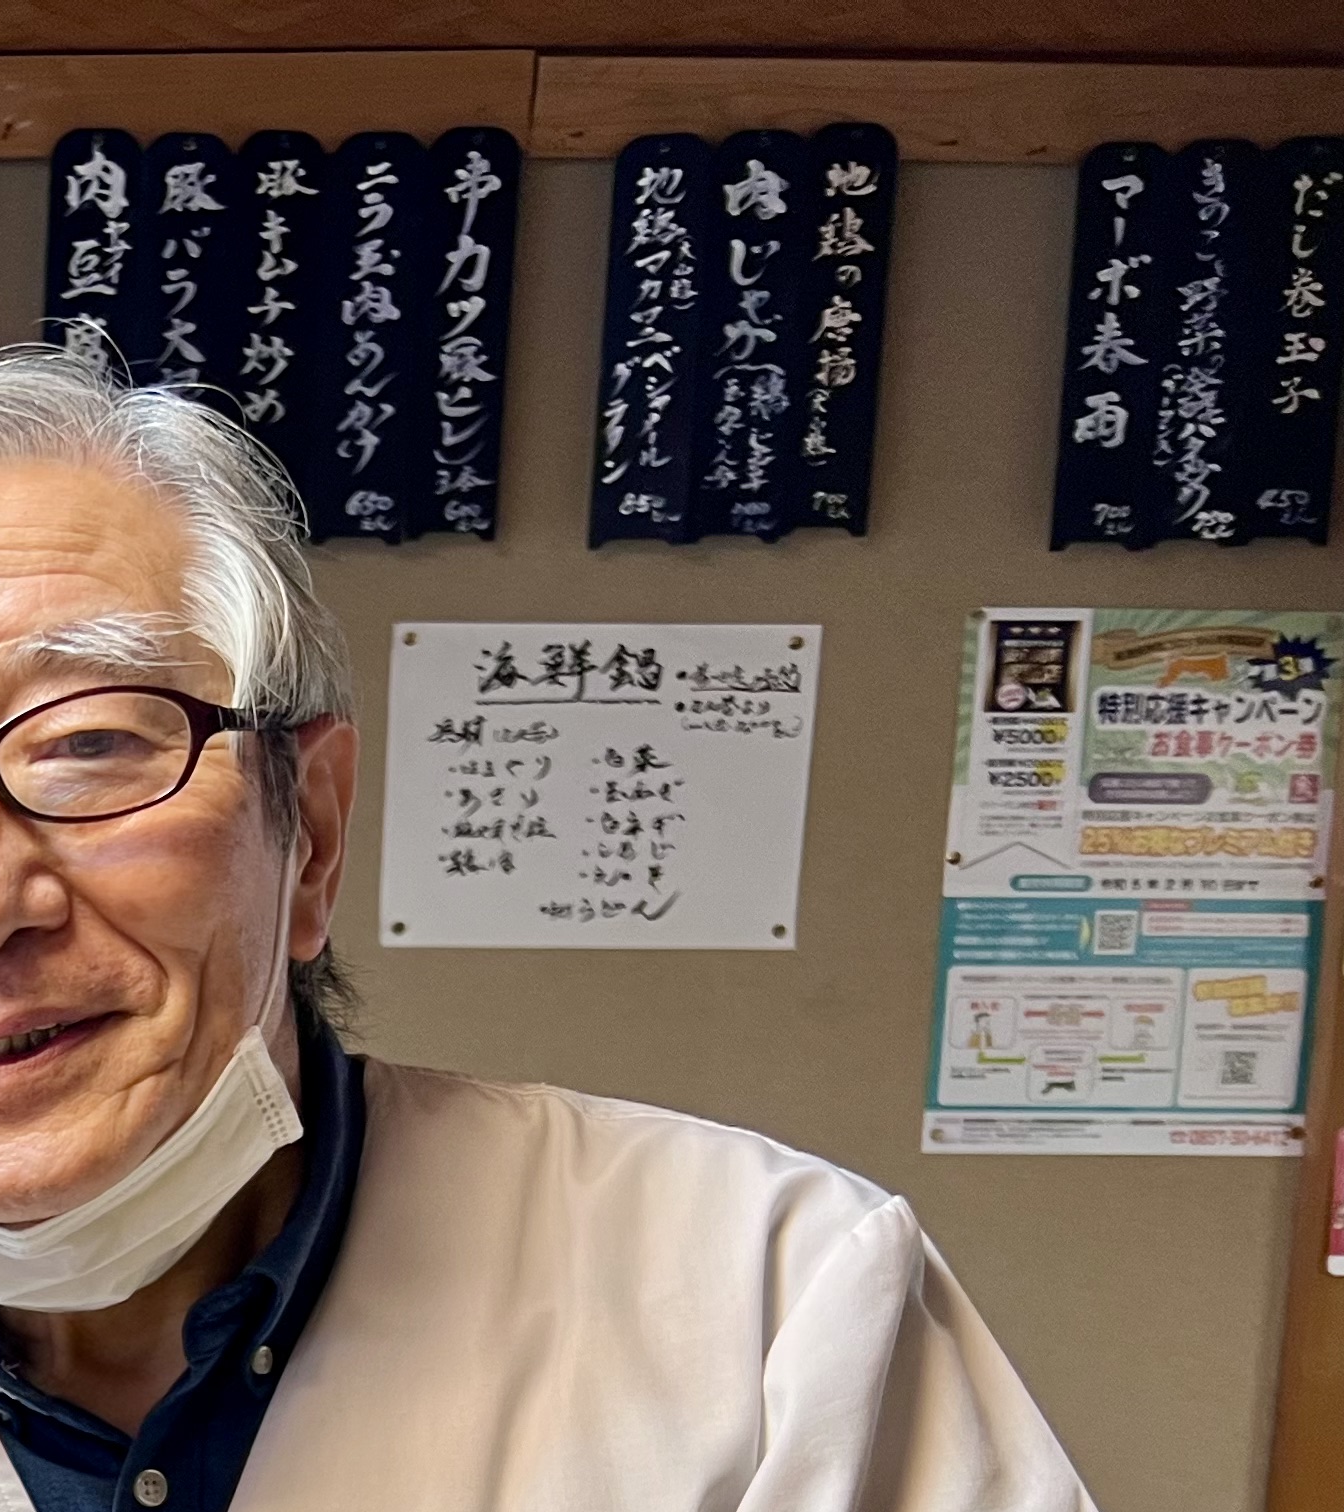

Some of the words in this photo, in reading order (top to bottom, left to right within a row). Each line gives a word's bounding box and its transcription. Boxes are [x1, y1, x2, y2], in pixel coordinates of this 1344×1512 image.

[1073, 173, 1153, 450] マーボ春雨
[1270, 171, 1343, 415] だし巻玉子
[1097, 691, 1322, 726] 特別応援キャンペーン
